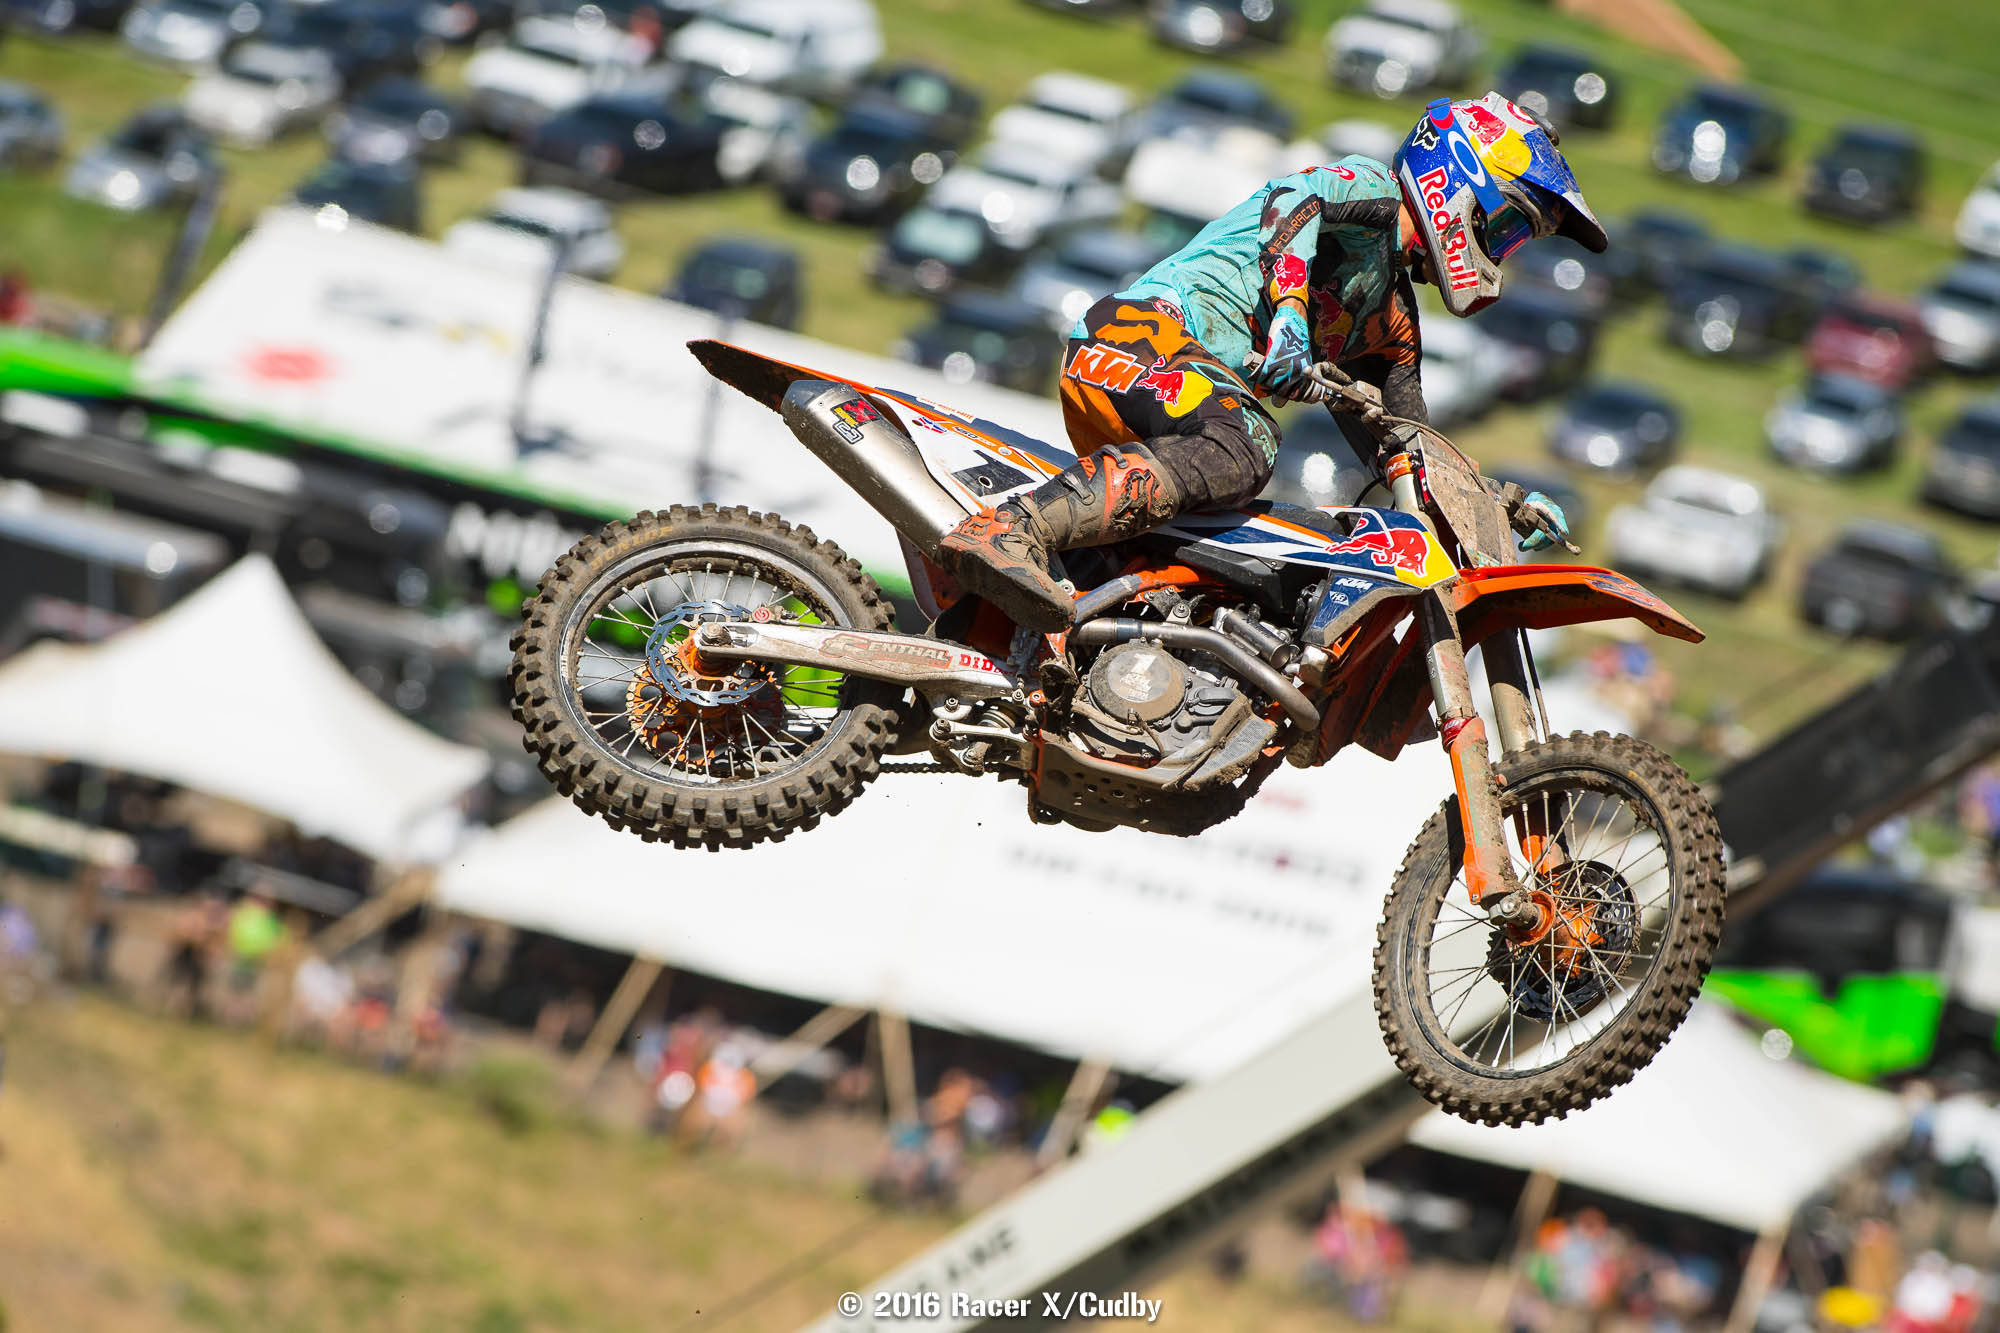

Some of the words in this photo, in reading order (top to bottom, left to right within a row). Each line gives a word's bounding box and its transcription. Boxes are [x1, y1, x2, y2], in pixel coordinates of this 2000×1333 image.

[1290, 201, 1321, 230] RACIN
[1416, 166, 1464, 234] Red
[1440, 229, 1480, 292] Bull
[1067, 343, 1147, 394] KTM
[1335, 577, 1374, 591] KTM
